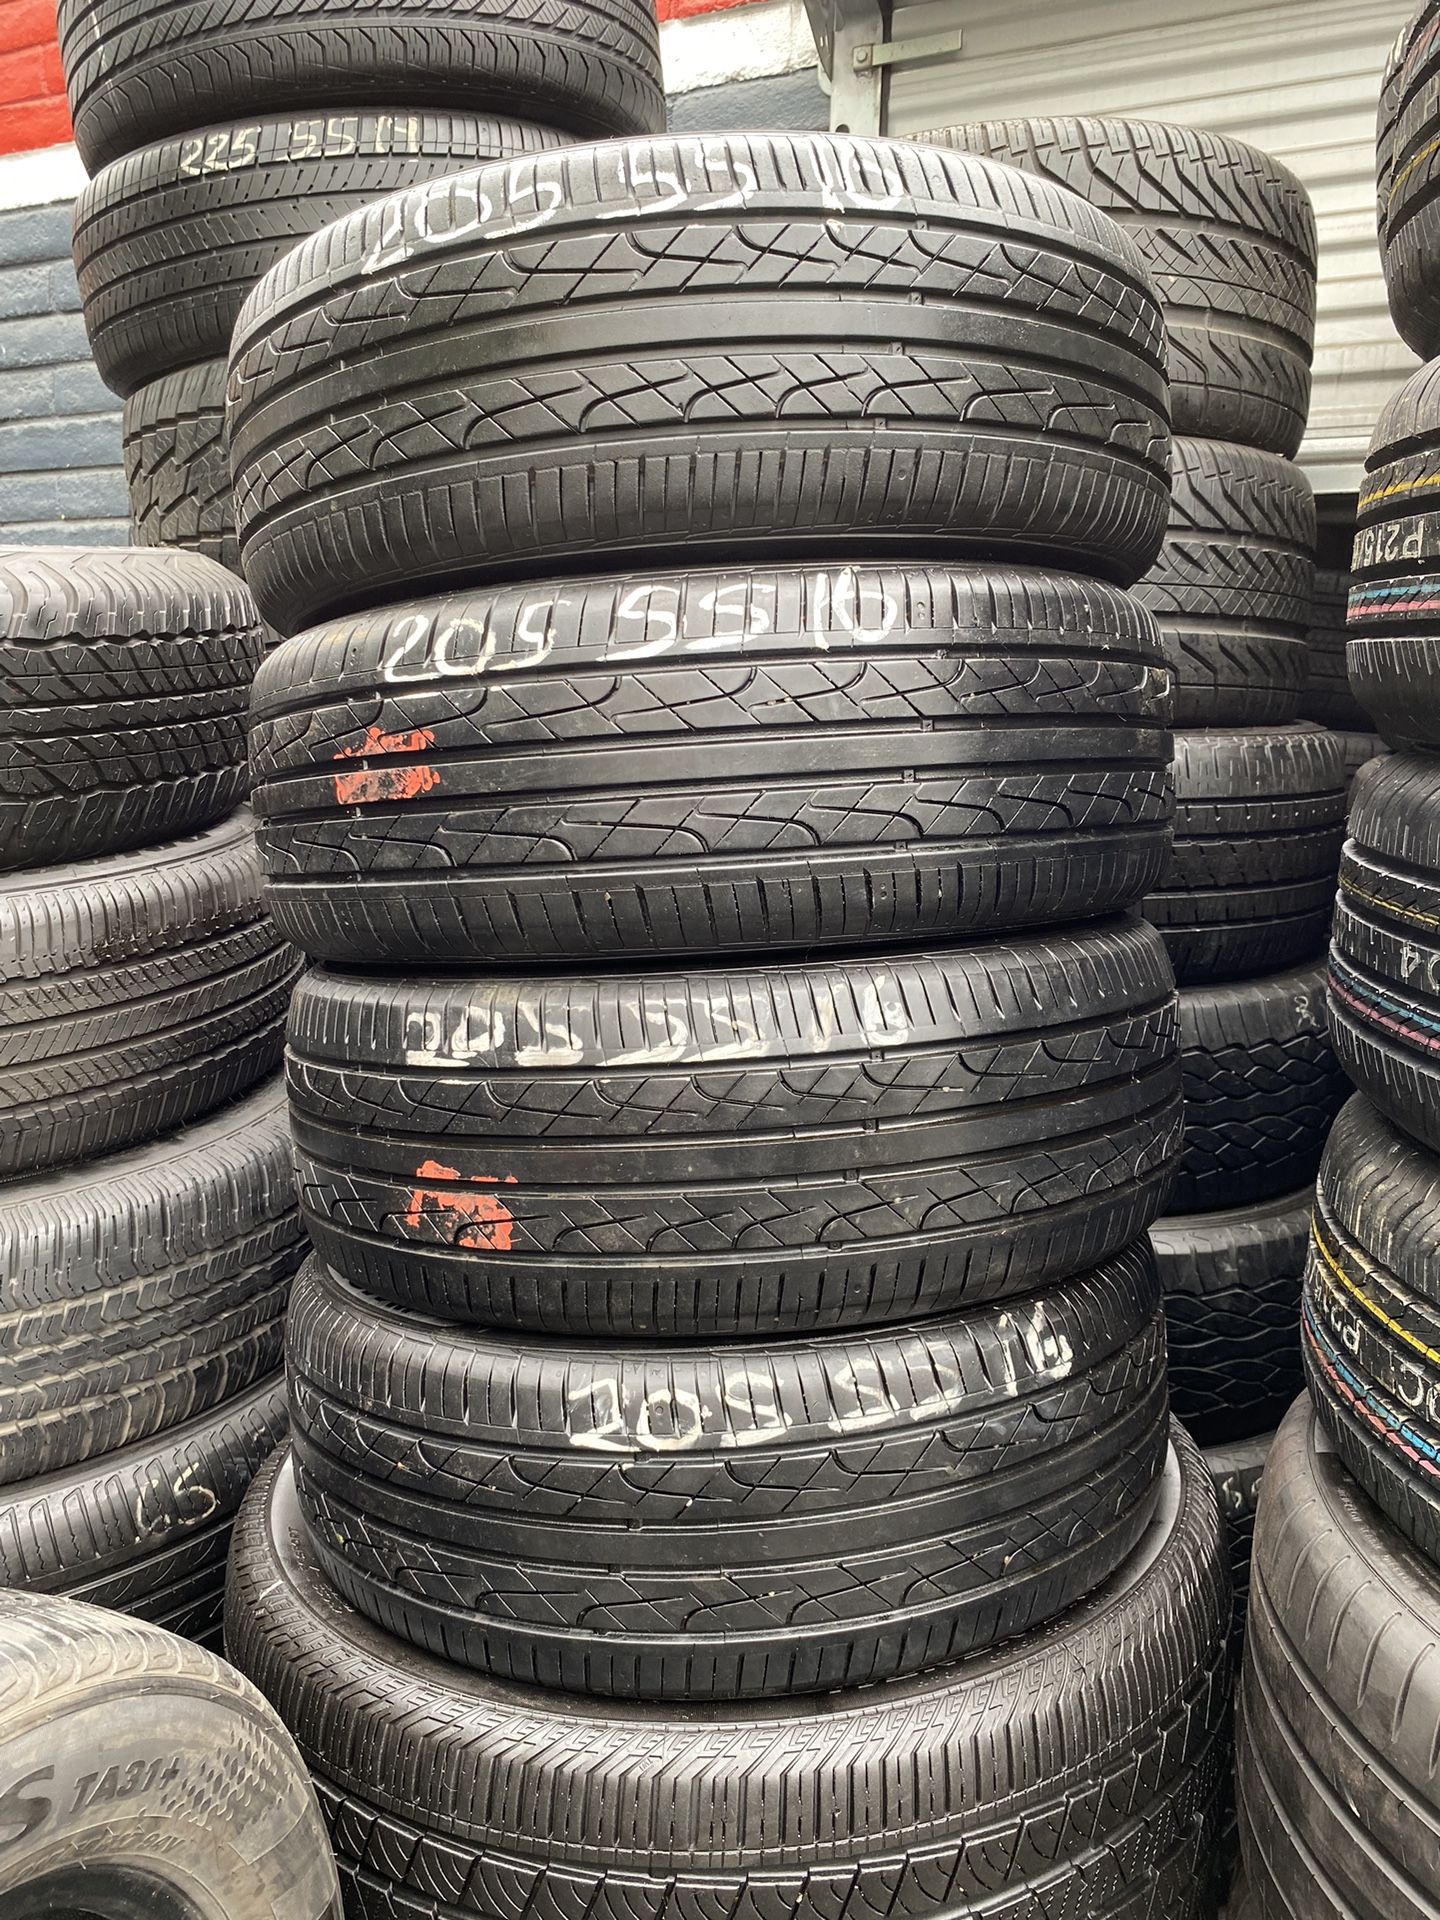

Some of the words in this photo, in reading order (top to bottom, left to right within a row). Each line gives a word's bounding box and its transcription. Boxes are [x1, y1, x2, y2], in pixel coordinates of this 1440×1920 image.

[179, 125, 262, 175] 225
[275, 116, 359, 161] 55
[361, 163, 562, 275] 205
[597, 142, 758, 227] 55
[384, 600, 572, 683] 205
[596, 584, 776, 662] 55
[402, 999, 590, 1068] 205
[595, 994, 780, 1066] 55
[568, 1372, 793, 1452] 205
[827, 1340, 967, 1434] 55
[998, 1300, 1075, 1398] 16
[68, 1756, 181, 1814] TA31+
